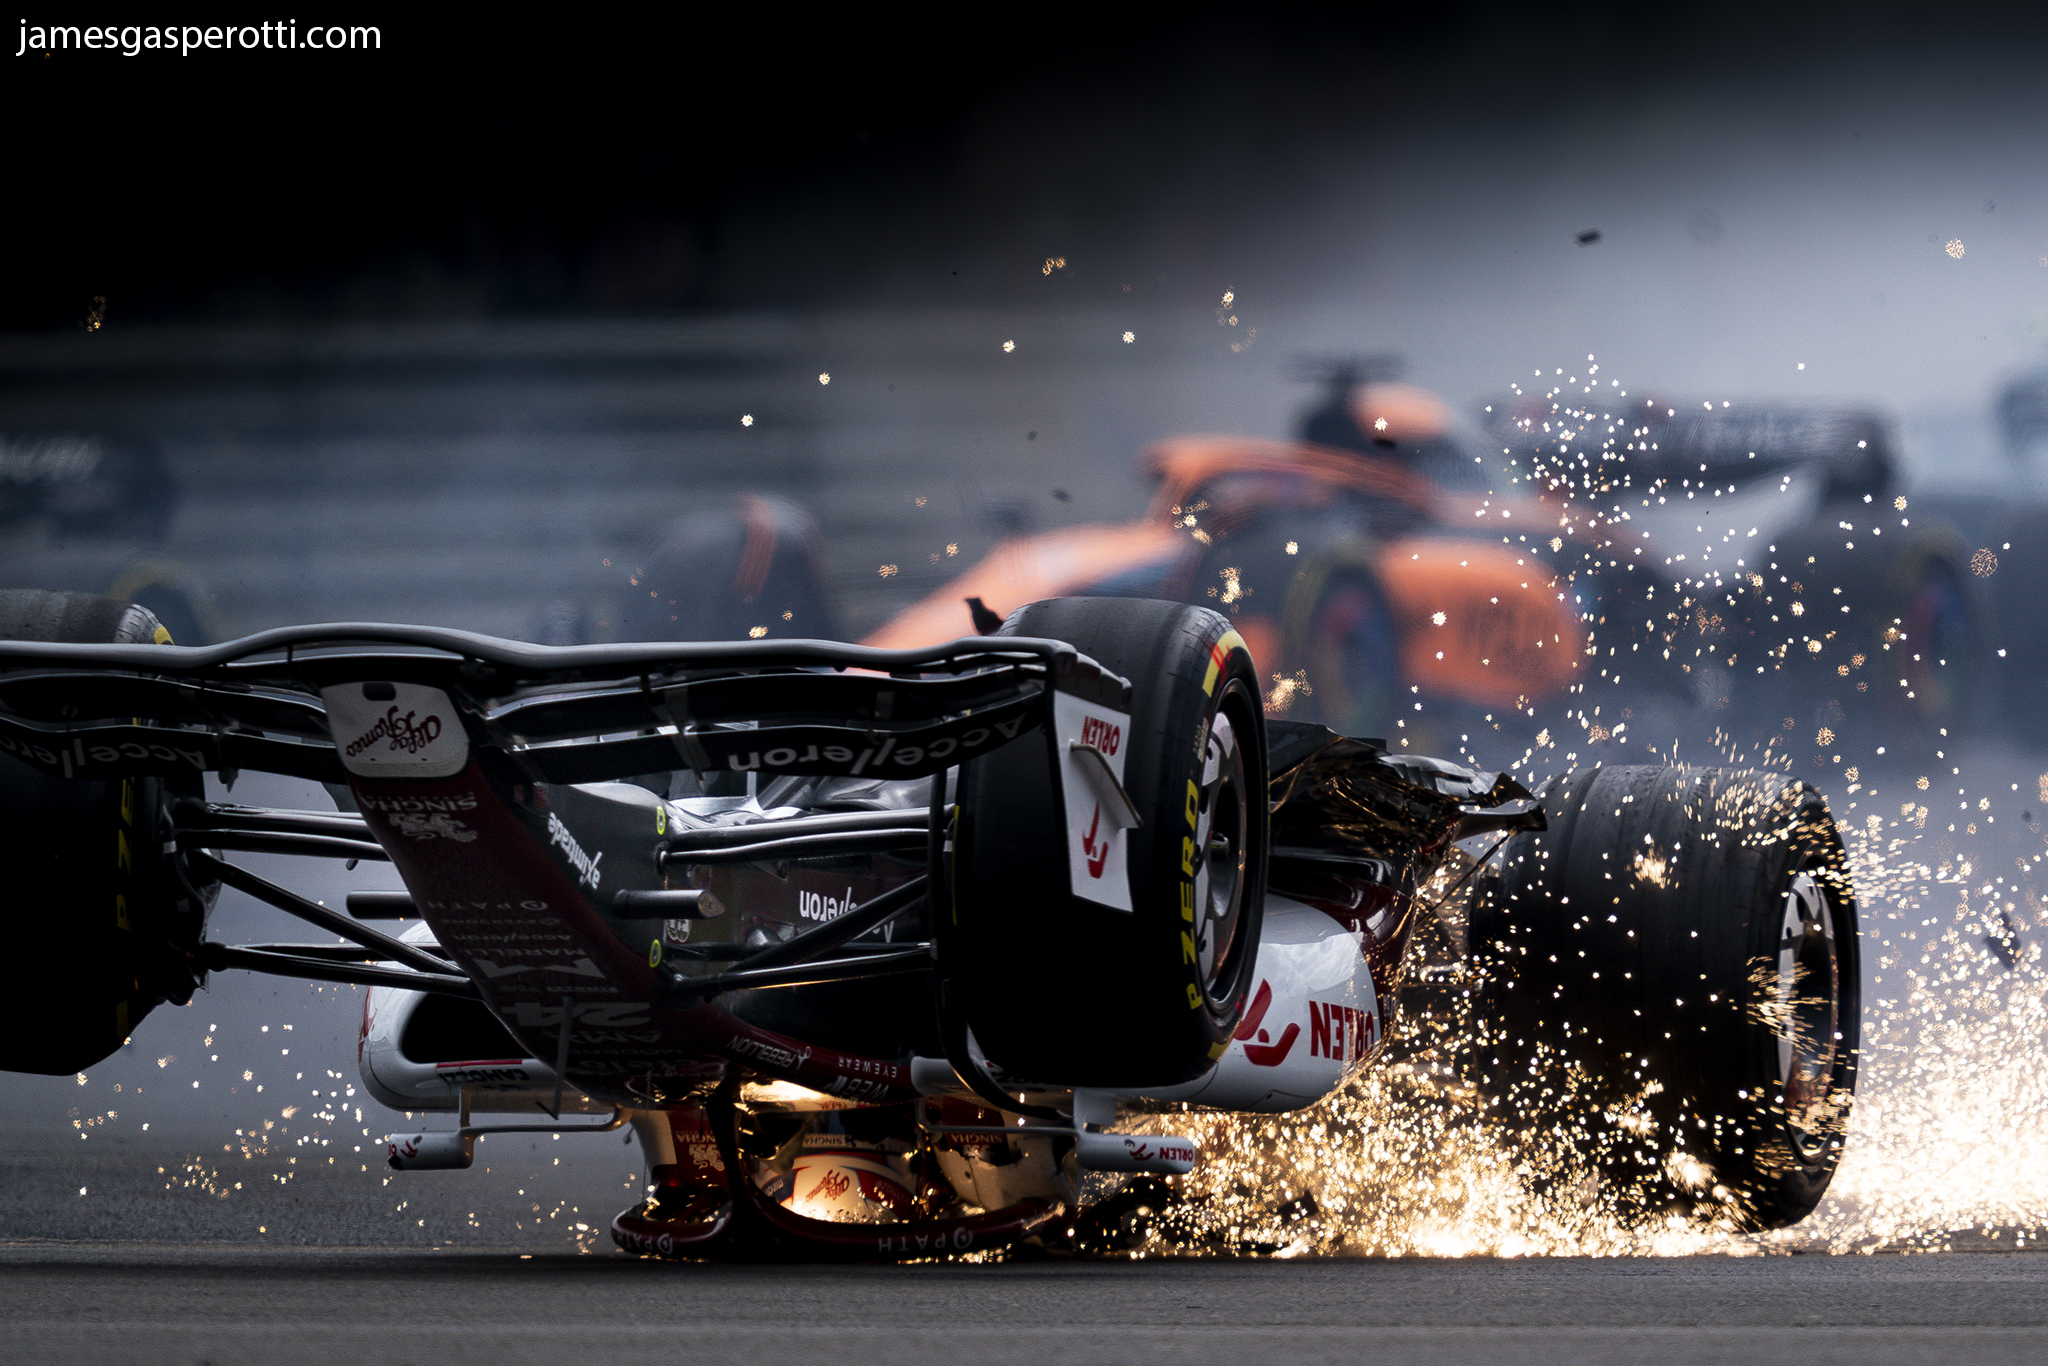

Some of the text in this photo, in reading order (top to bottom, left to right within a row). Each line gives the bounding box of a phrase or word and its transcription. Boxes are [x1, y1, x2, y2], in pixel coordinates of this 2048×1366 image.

[346, 706, 406, 757] Romeo
[1083, 716, 1119, 756] ORLEN
[729, 713, 1027, 775] Accelleron
[359, 796, 478, 812] SINGHA
[115, 777, 135, 932] P ZE
[548, 812, 602, 890] aximtrade
[428, 901, 511, 909] PATH
[1180, 778, 1202, 1010] P ZERO
[454, 934, 571, 942] Accelleron
[466, 948, 586, 956] MARELLI
[502, 1003, 651, 1027] 24
[1309, 1001, 1374, 1061] ORLEN
[725, 1035, 796, 1068] REBELLION
[439, 1069, 529, 1083] CAMOZZI
[838, 1055, 897, 1078] EYEWEAR
[676, 1134, 717, 1144] NGHA
[804, 1136, 843, 1145] SINGHA
[951, 1134, 1003, 1144] SINGHA
[1159, 1147, 1193, 1163] ORLEN
[878, 1232, 946, 1253] PATH
